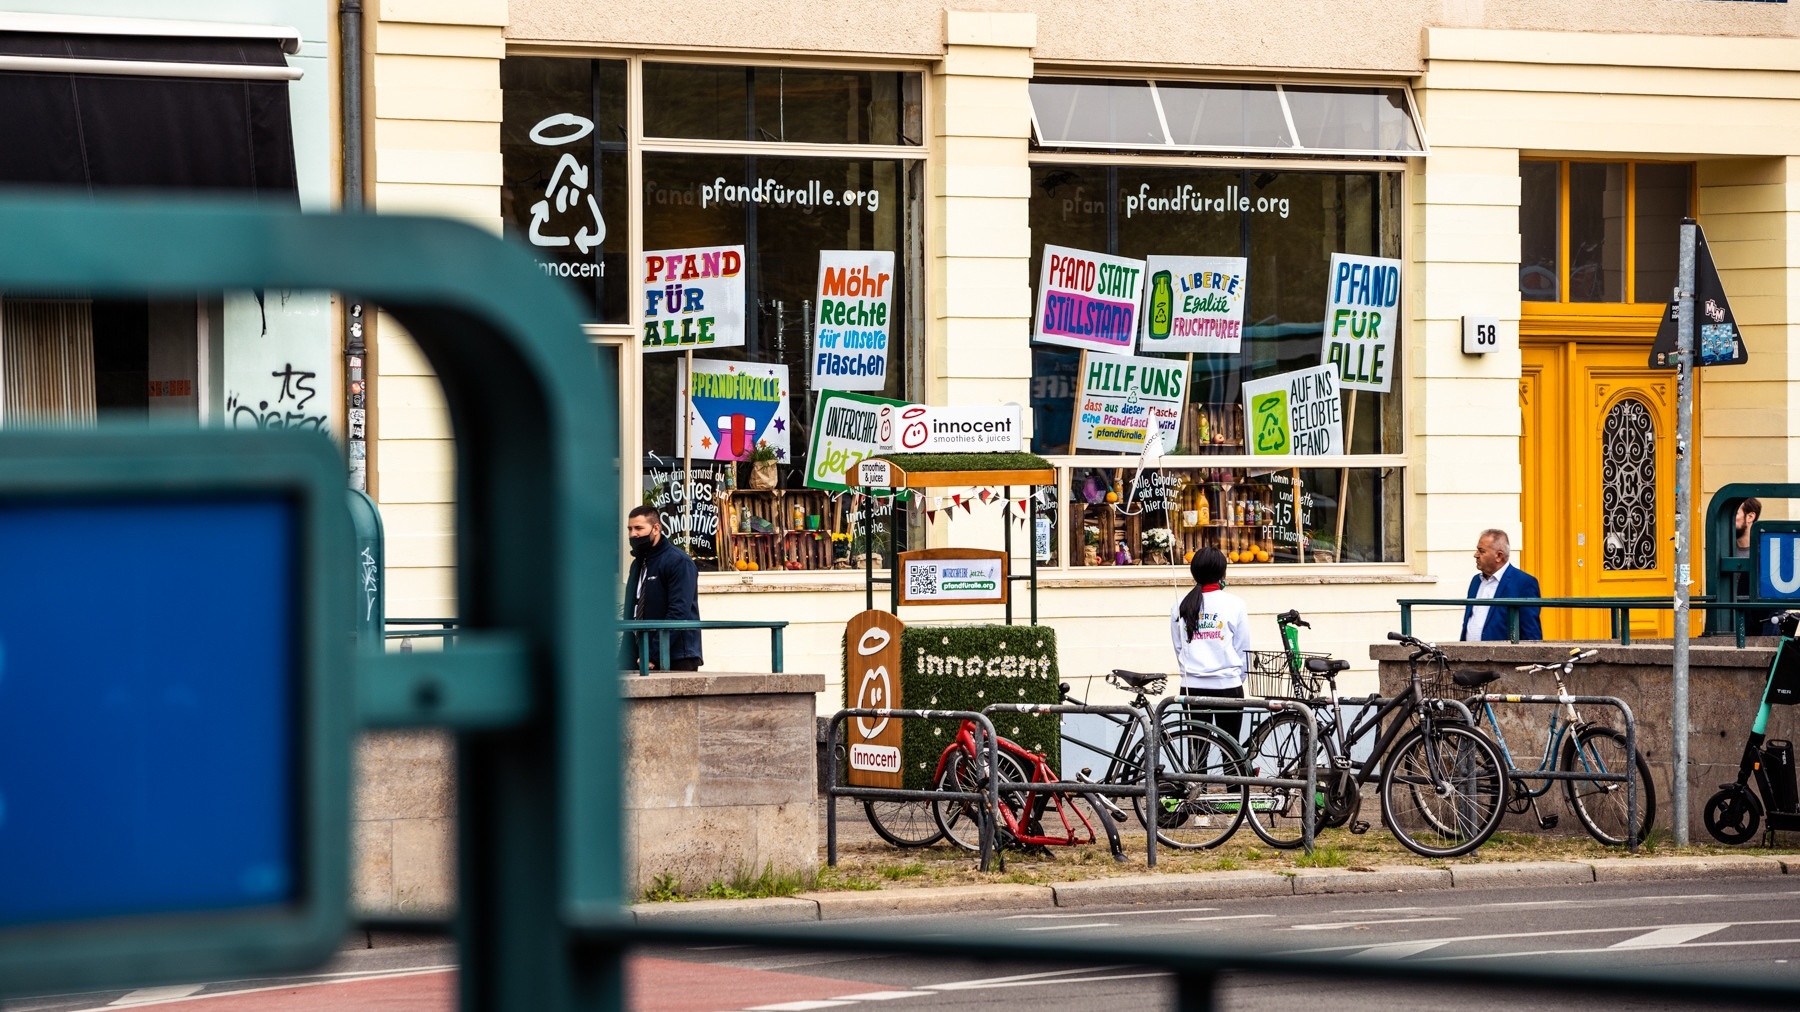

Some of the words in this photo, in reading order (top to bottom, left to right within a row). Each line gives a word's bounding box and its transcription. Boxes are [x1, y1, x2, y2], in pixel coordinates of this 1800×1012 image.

[702, 177, 879, 212] pfandfüralle.org
[1127, 183, 1289, 219] pfandfüralle.org
[534, 259, 605, 278] nnocent
[645, 250, 741, 284] PFAND
[1097, 262, 1140, 299] STATT
[822, 265, 890, 297] Möhr
[1180, 271, 1240, 296] LIBERTÉ
[1334, 261, 1398, 308] PFAND
[645, 284, 705, 318] FÜR
[820, 299, 887, 327] Rechte
[1182, 293, 1230, 314] Egalité
[643, 317, 715, 347] ALLE
[1173, 317, 1241, 339] FRUCHTPÜREE
[1332, 309, 1382, 340] FÜR
[1477, 324, 1496, 345] 58
[819, 329, 841, 349] für
[843, 330, 887, 349] unsere
[817, 353, 884, 376] Flaschen
[1327, 341, 1385, 384] ALLE
[1087, 362, 1137, 392] HILF
[1140, 367, 1182, 397] UNS
[1290, 375, 1311, 405] AUF
[1315, 370, 1333, 396] INS
[1084, 399, 1102, 412] dass
[1104, 403, 1118, 413] aus
[1121, 403, 1145, 414] dieser
[1291, 397, 1340, 433] GELOBTE
[933, 418, 1011, 433] innocent
[1082, 413, 1101, 424] eine
[1158, 420, 1176, 430] wird
[933, 434, 975, 442] smoothies
[986, 434, 1011, 443] juices
[1293, 428, 1330, 455] PFAND
[650, 466, 668, 486] Hier
[715, 464, 725, 482] du
[862, 462, 886, 472] smoothies
[864, 472, 869, 482] &
[868, 472, 884, 484] juices
[671, 479, 712, 502] Gutes
[660, 510, 719, 539] Smoothie
[1769, 537, 1800, 594] U
[943, 582, 994, 590] pfandfüralle.org
[917, 647, 1051, 679] innocent
[853, 747, 897, 768] innocent
